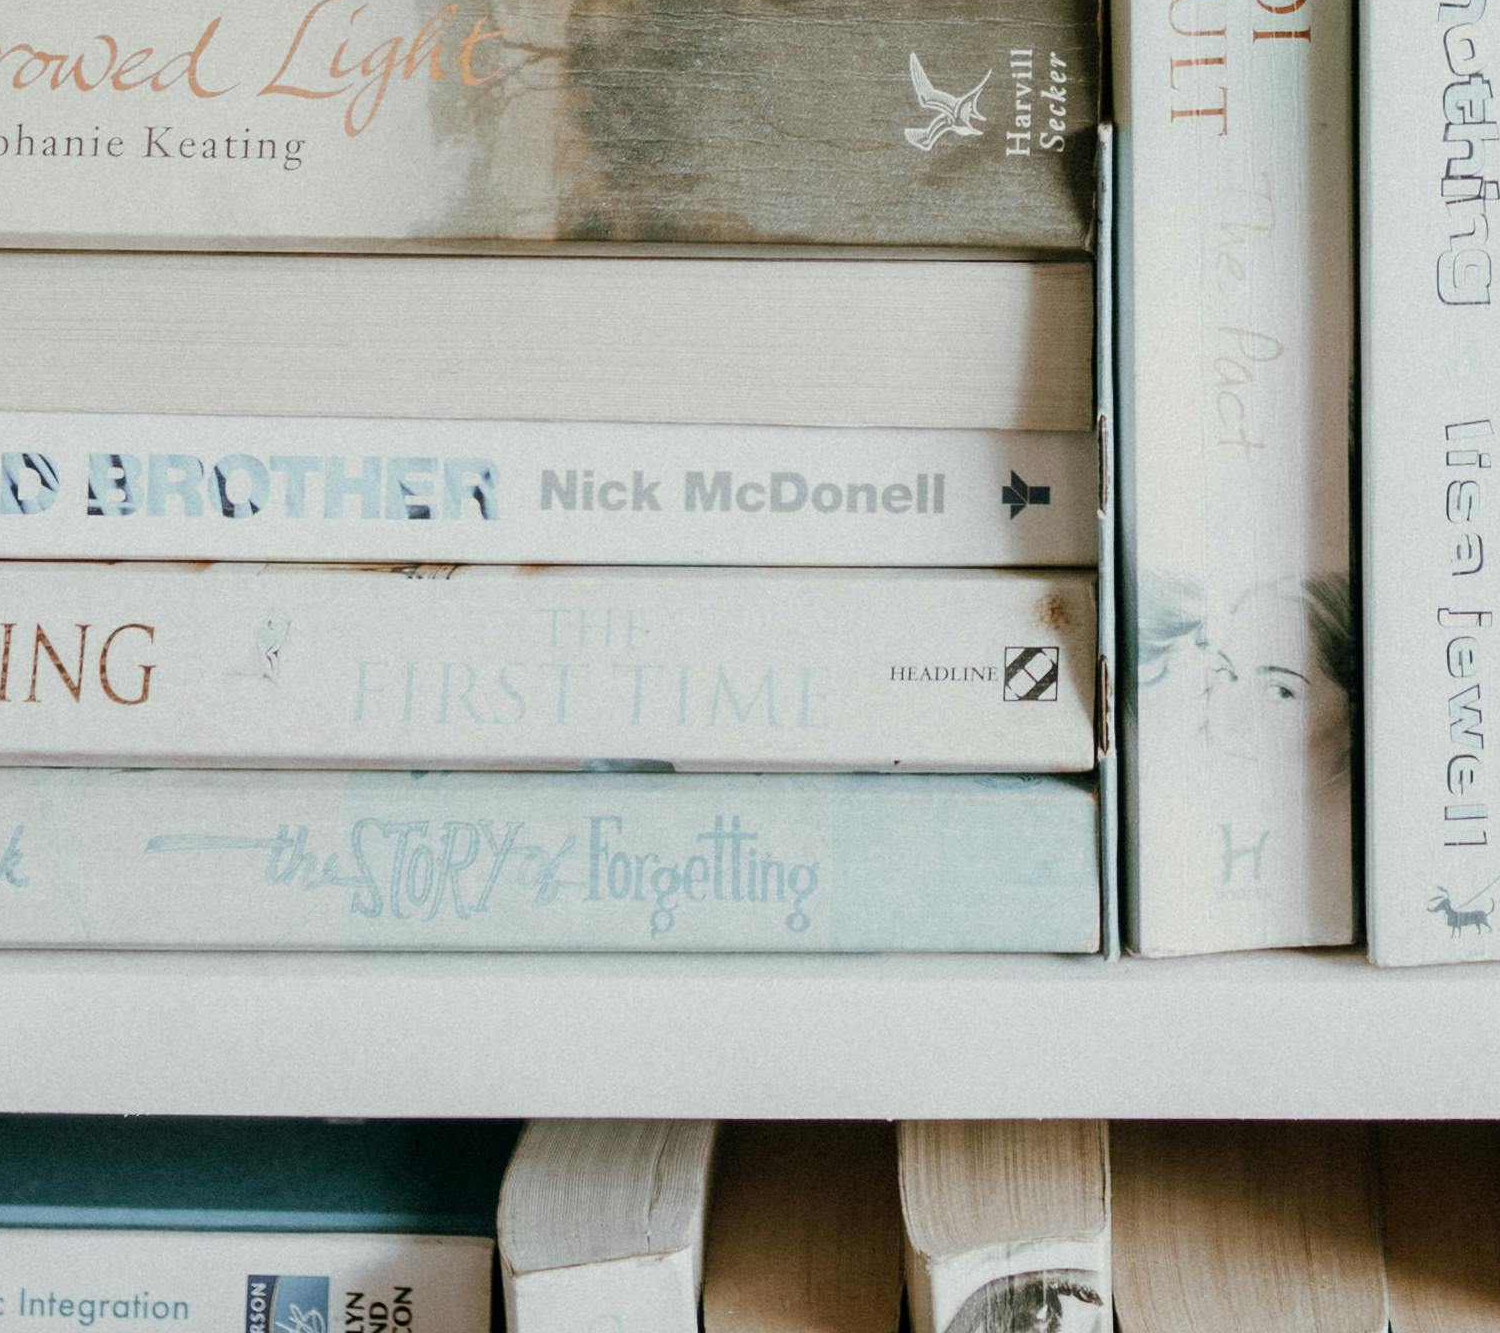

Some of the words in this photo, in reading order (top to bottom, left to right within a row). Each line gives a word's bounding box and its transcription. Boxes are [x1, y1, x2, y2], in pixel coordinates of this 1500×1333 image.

[144, 126, 308, 171] Keating
[889, 665, 1000, 684] HEADLINE
[18, 1288, 191, 1323] Integration
